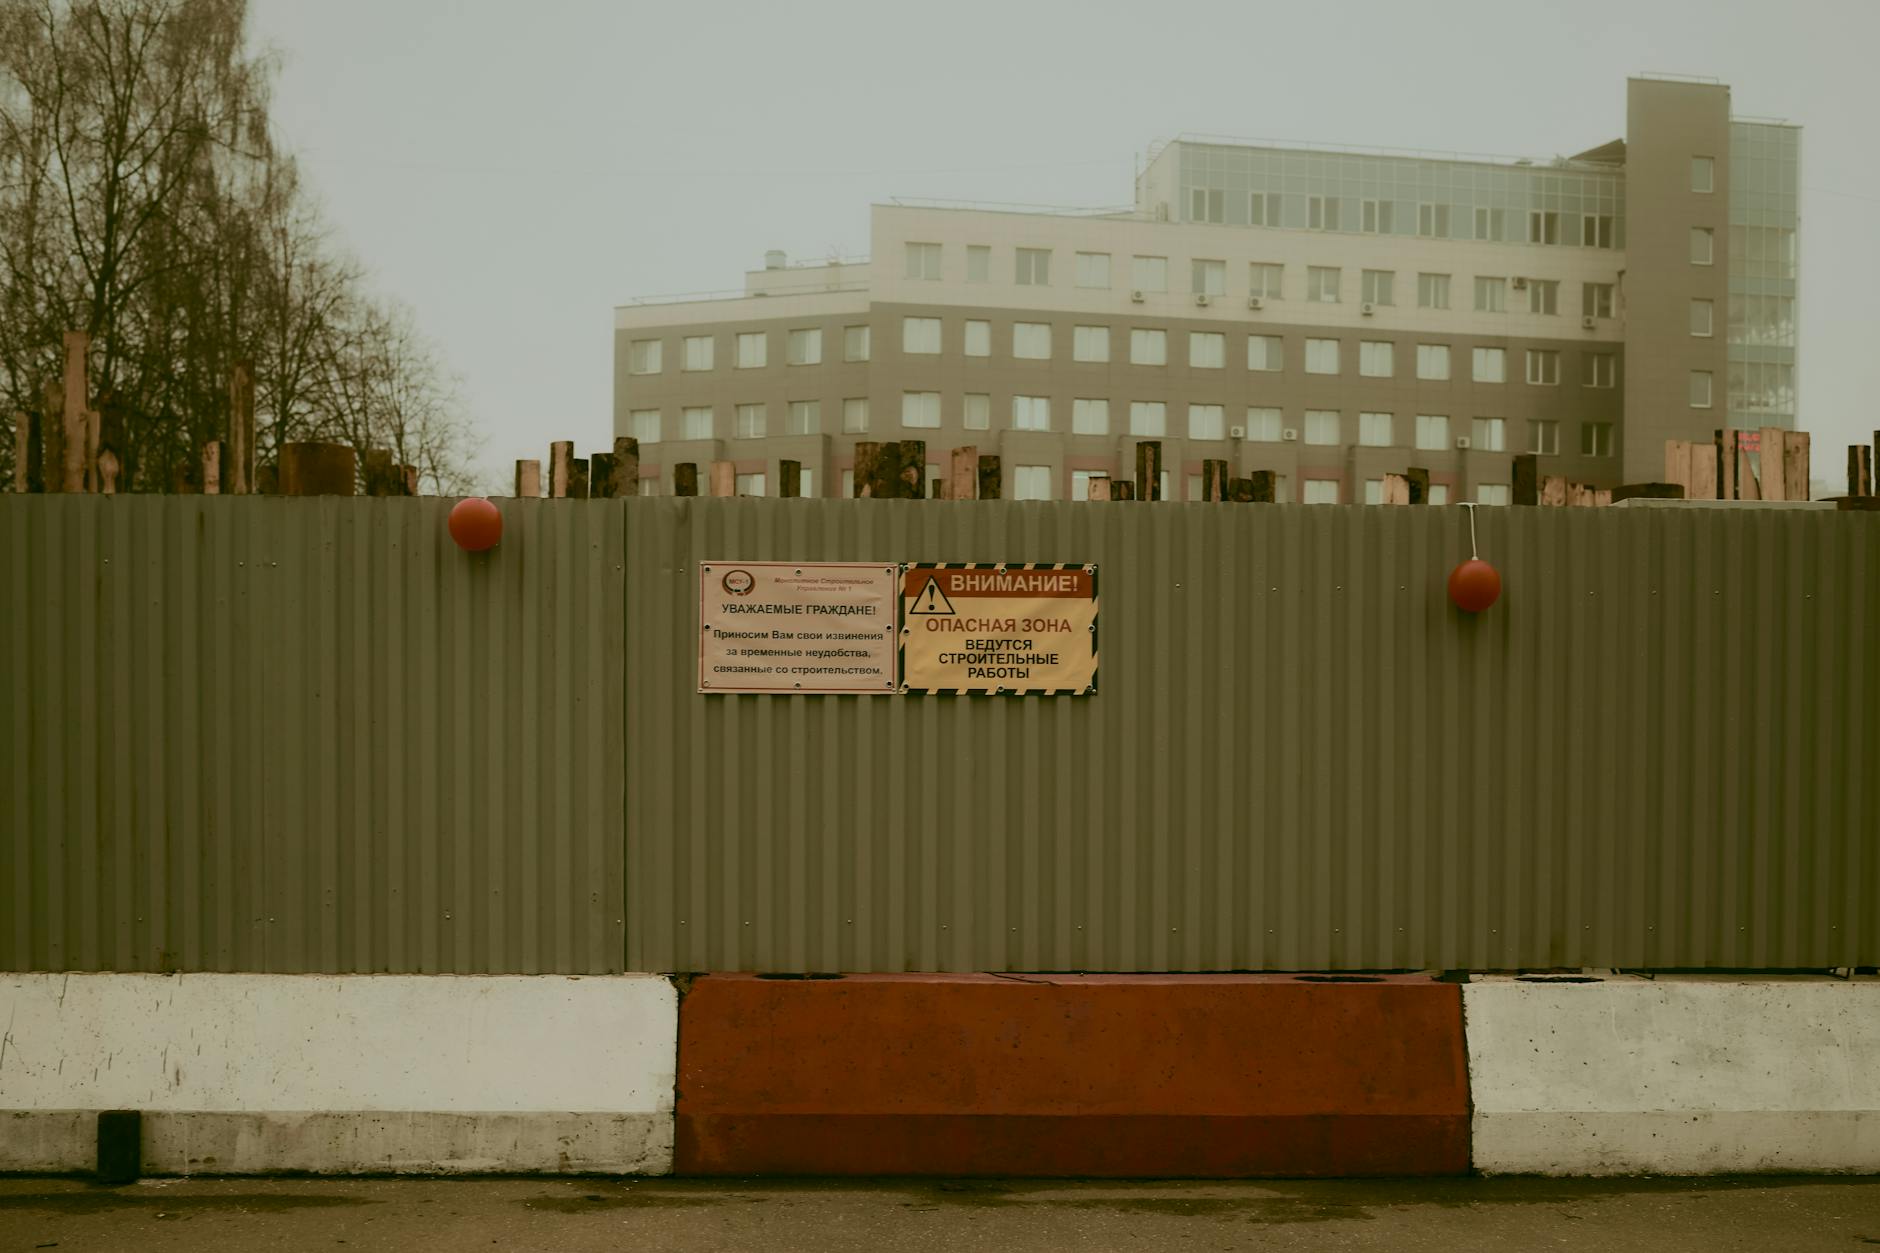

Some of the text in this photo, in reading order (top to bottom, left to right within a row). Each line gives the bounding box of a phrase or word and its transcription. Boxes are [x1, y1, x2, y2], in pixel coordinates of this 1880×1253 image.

[950, 574, 1078, 592] ВНИМАНИЕ!
[721, 603, 876, 616] УВАЖАЕМЫЕ ГРАЖДАНЕ!
[925, 617, 1072, 633] ОПАСНАЯ ЗОНА
[713, 629, 883, 641] Приносим Вам свои извинения
[965, 639, 1032, 652] ВЕДУТСЯ
[725, 648, 871, 658] за временные неудобства,
[938, 653, 1059, 665] СТРОИТЕЛЬНЫЕ
[713, 665, 883, 675] связанные со строительством.
[967, 667, 1030, 679] РАБОТЫ
